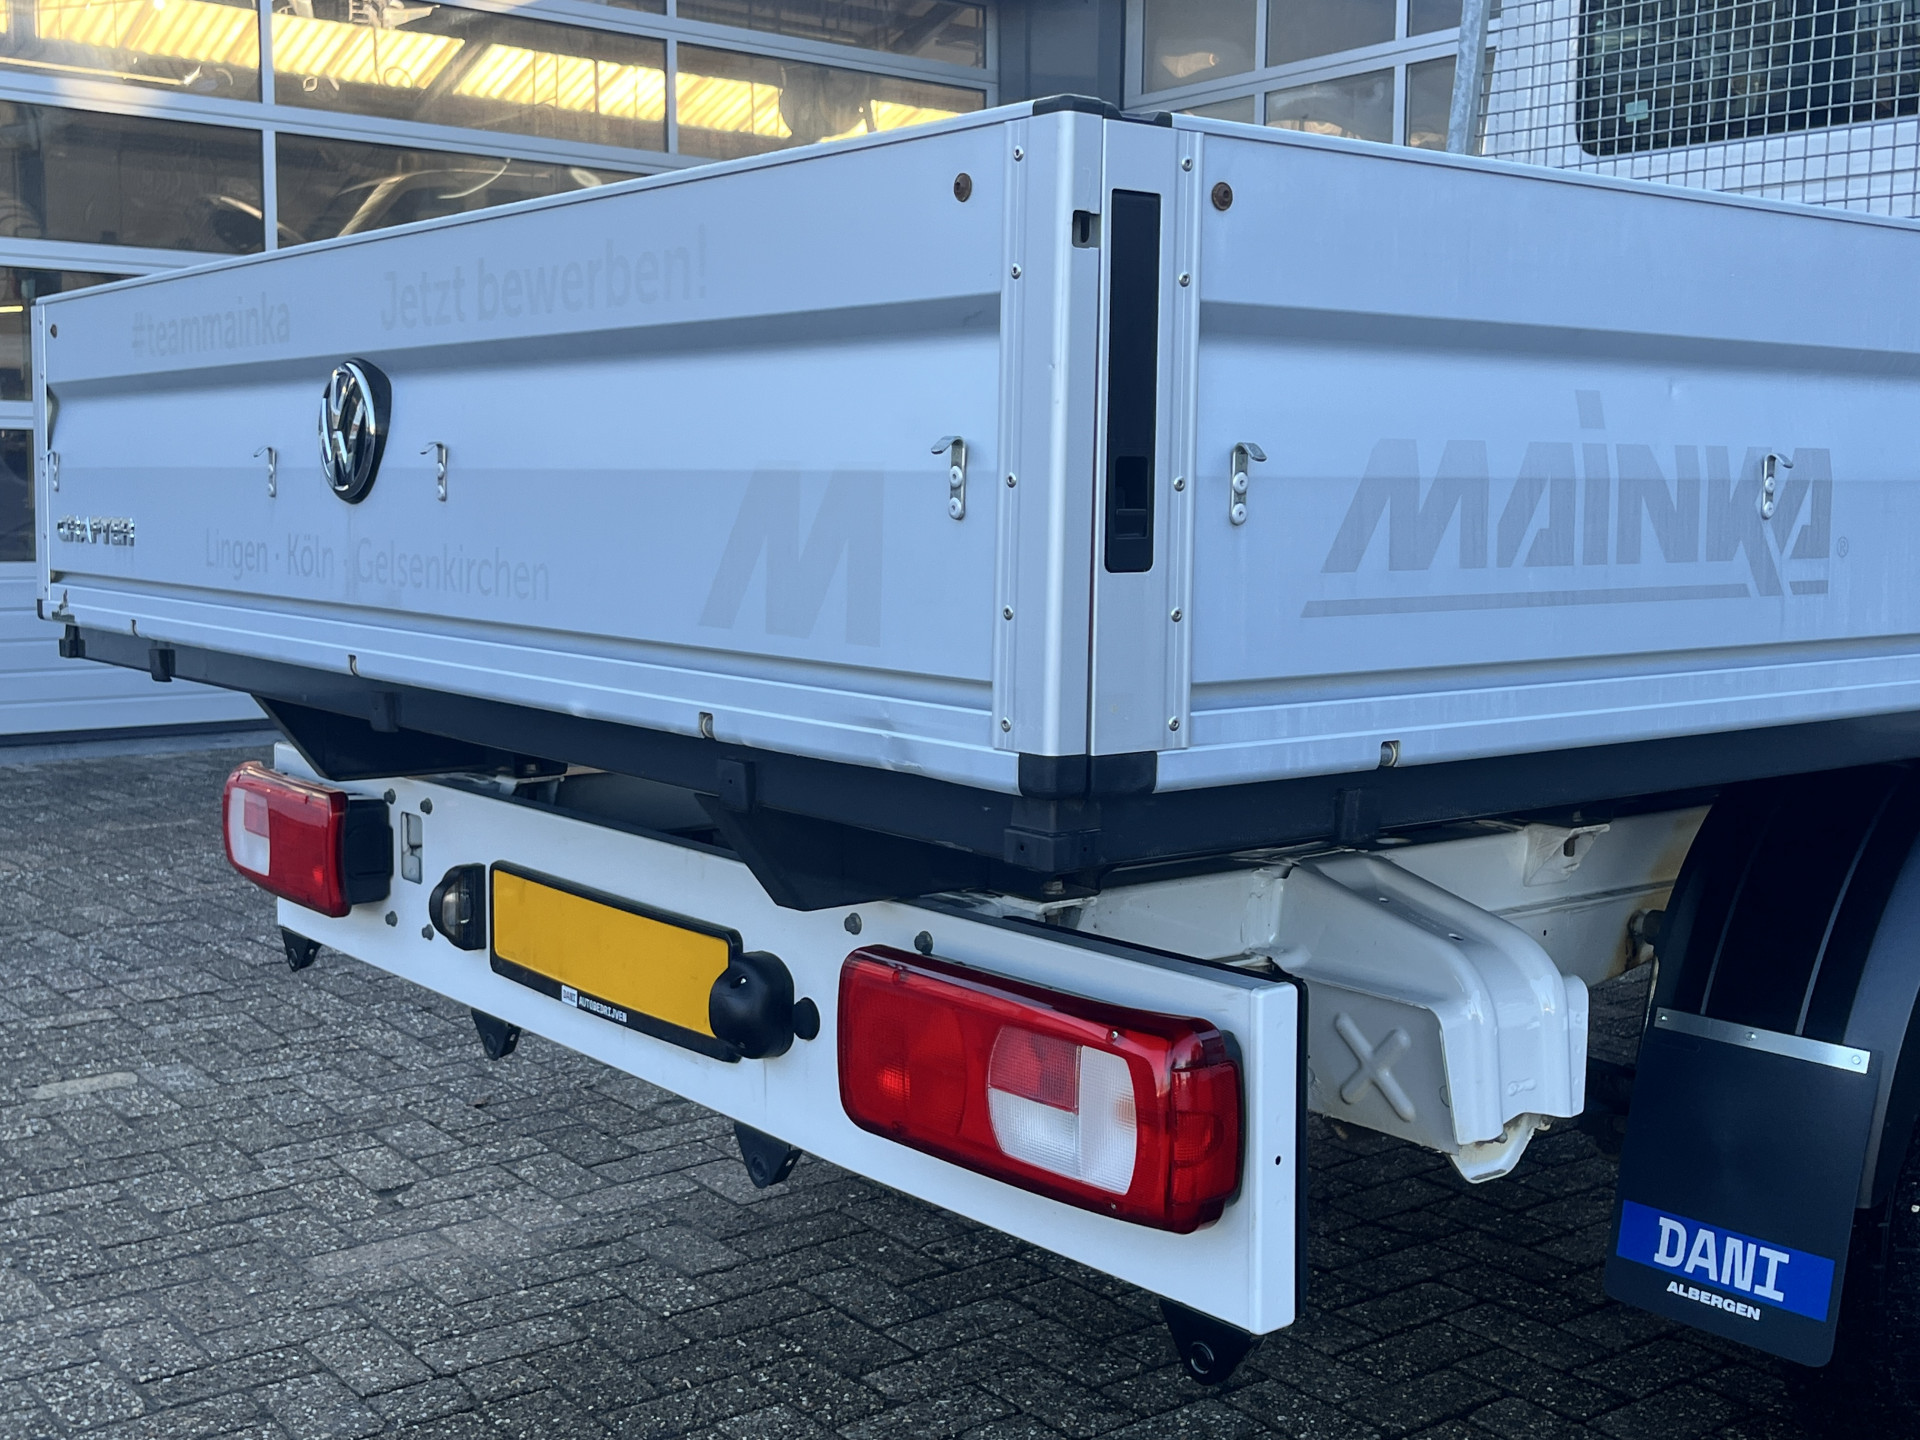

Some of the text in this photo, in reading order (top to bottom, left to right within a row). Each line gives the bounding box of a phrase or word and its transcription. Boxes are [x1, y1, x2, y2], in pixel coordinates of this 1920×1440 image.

[381, 222, 707, 332] Jetzt bewerben!
[131, 291, 291, 358] #teammainka
[205, 528, 268, 581] Lingen
[288, 532, 334, 578] Köln
[356, 537, 549, 601] Gelsenkirchen
[698, 461, 885, 648] M
[1653, 1216, 1790, 1303] DANI
[1666, 1281, 1761, 1321] ALBERGEN
